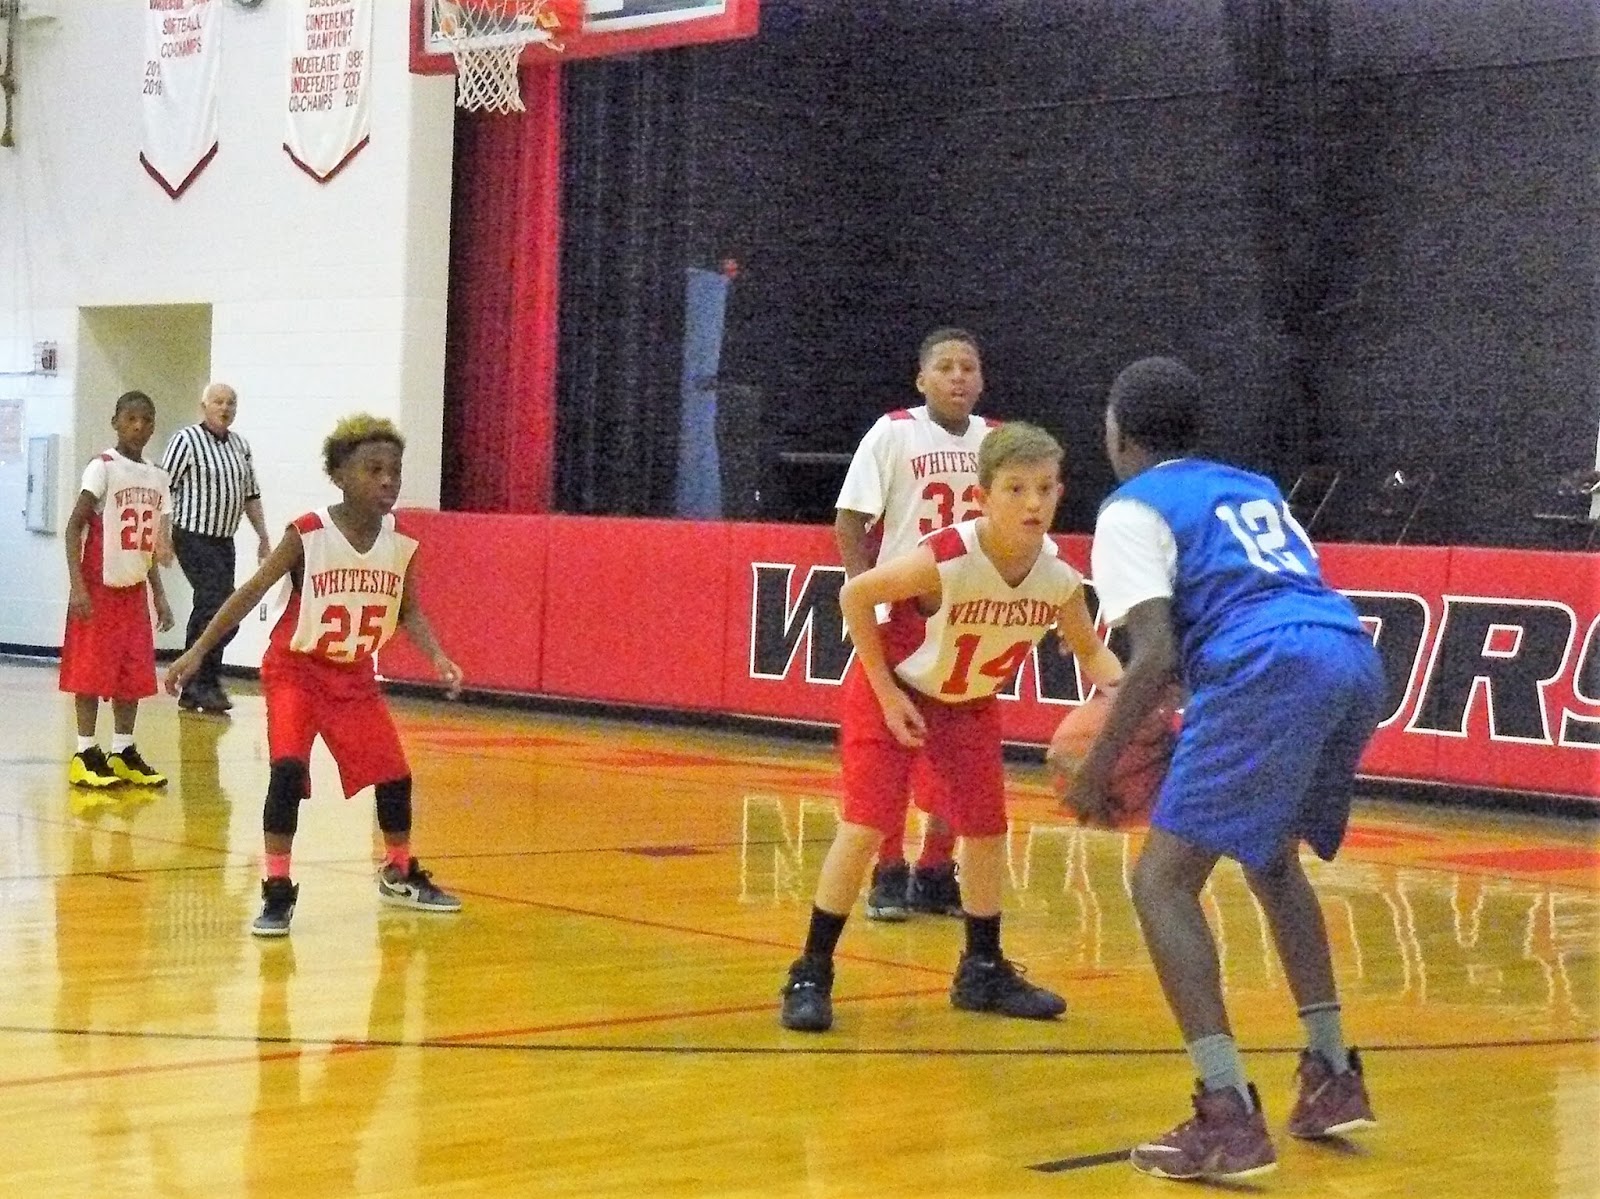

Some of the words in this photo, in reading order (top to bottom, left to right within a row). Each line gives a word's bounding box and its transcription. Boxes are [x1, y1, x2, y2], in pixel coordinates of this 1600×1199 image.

[910, 451, 979, 480] WHITES
[317, 604, 388, 662] 25
[940, 633, 1033, 695] 14
